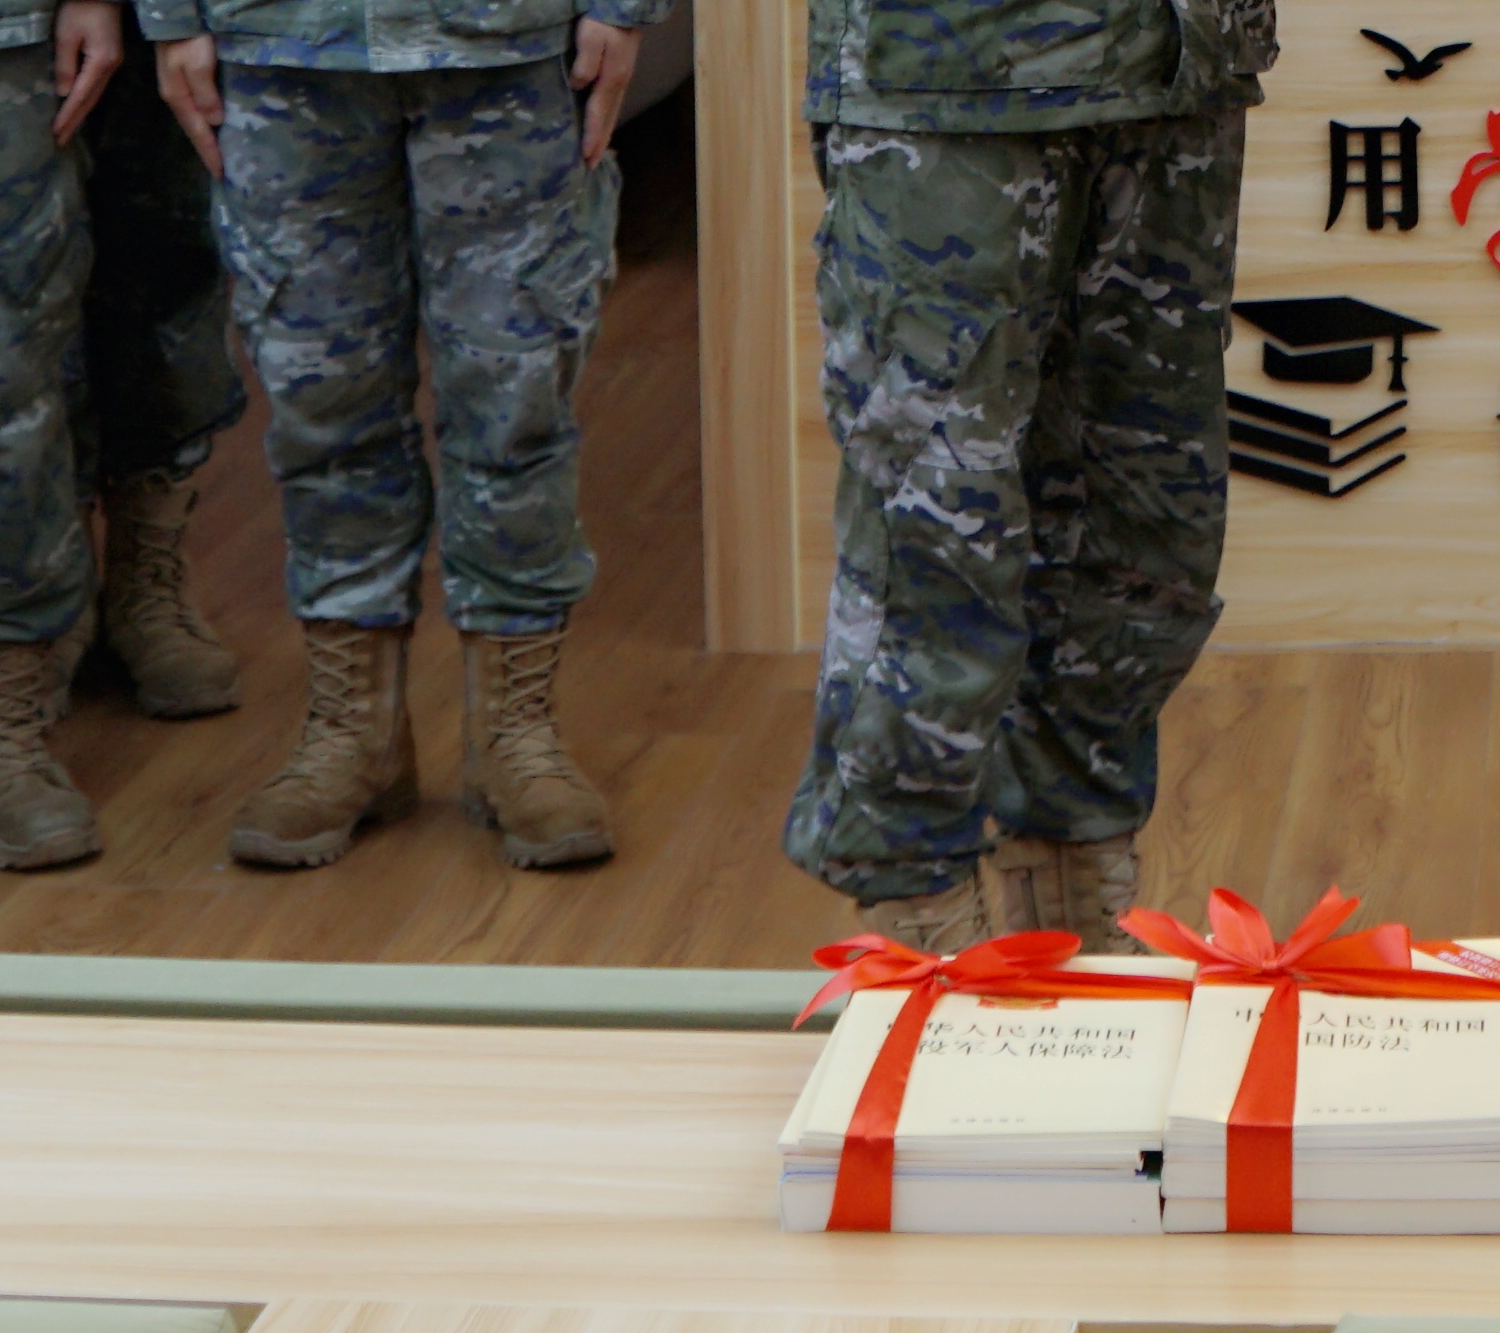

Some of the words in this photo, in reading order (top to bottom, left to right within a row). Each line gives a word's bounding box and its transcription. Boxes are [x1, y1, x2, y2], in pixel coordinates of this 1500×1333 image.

[1235, 1007, 1485, 1033] 中人民共和国
[887, 1021, 1136, 1041] 华人民共和国
[1305, 1032, 1411, 1051] 国防法
